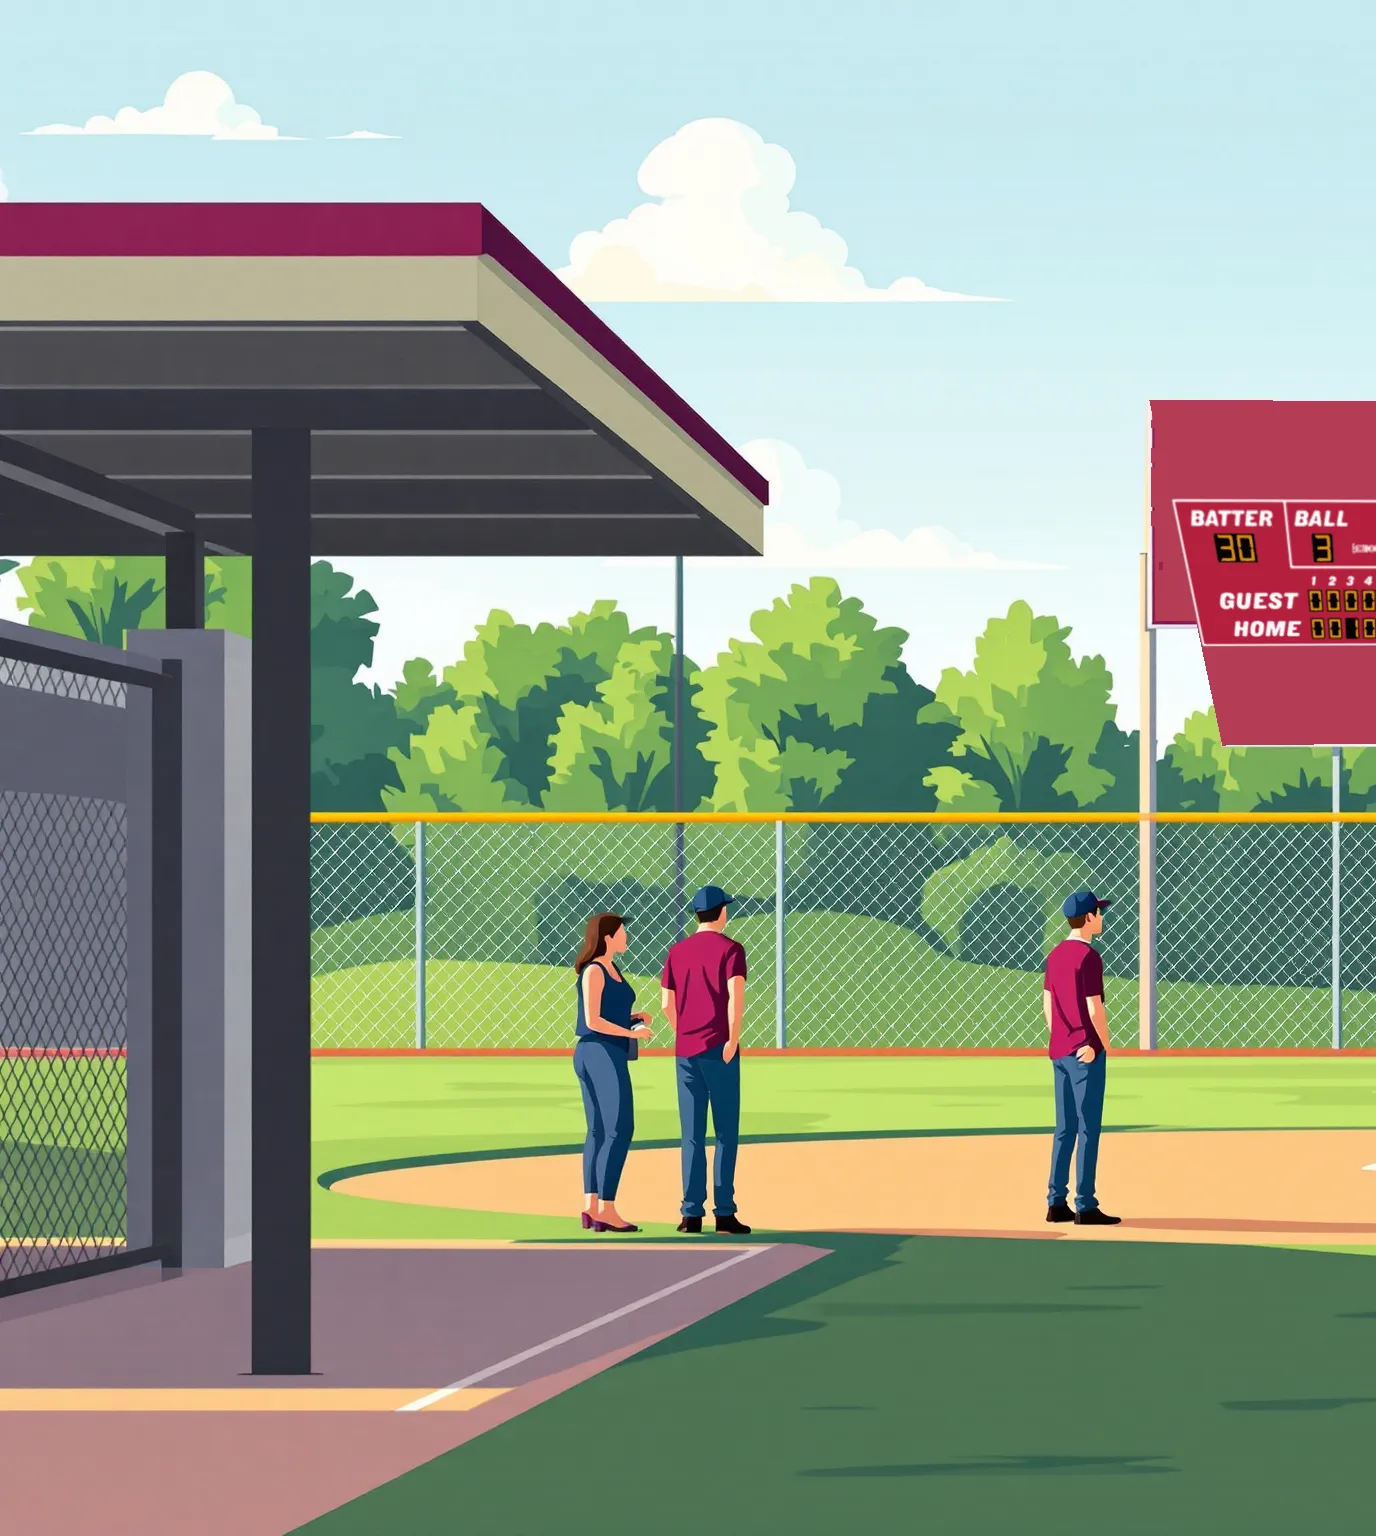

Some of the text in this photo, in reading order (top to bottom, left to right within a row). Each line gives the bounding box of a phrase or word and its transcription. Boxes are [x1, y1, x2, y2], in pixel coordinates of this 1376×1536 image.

[1191, 510, 1274, 527] BATTER
[1295, 510, 1349, 527] BALL
[1217, 535, 1256, 562] 30
[1314, 535, 1332, 562] 3
[1311, 576, 1317, 586] 1
[1328, 576, 1337, 586] 2
[1346, 576, 1355, 586] 3
[1363, 576, 1373, 586] 4
[1220, 592, 1299, 610] GUEST
[1309, 590, 1323, 612] 0
[1327, 590, 1341, 612] 0
[1345, 590, 1358, 612] 0
[1363, 590, 1376, 611] 0
[1234, 620, 1302, 637] HOME
[1311, 618, 1325, 638] 0
[1328, 618, 1342, 638] 0
[1363, 618, 1376, 638] 0
